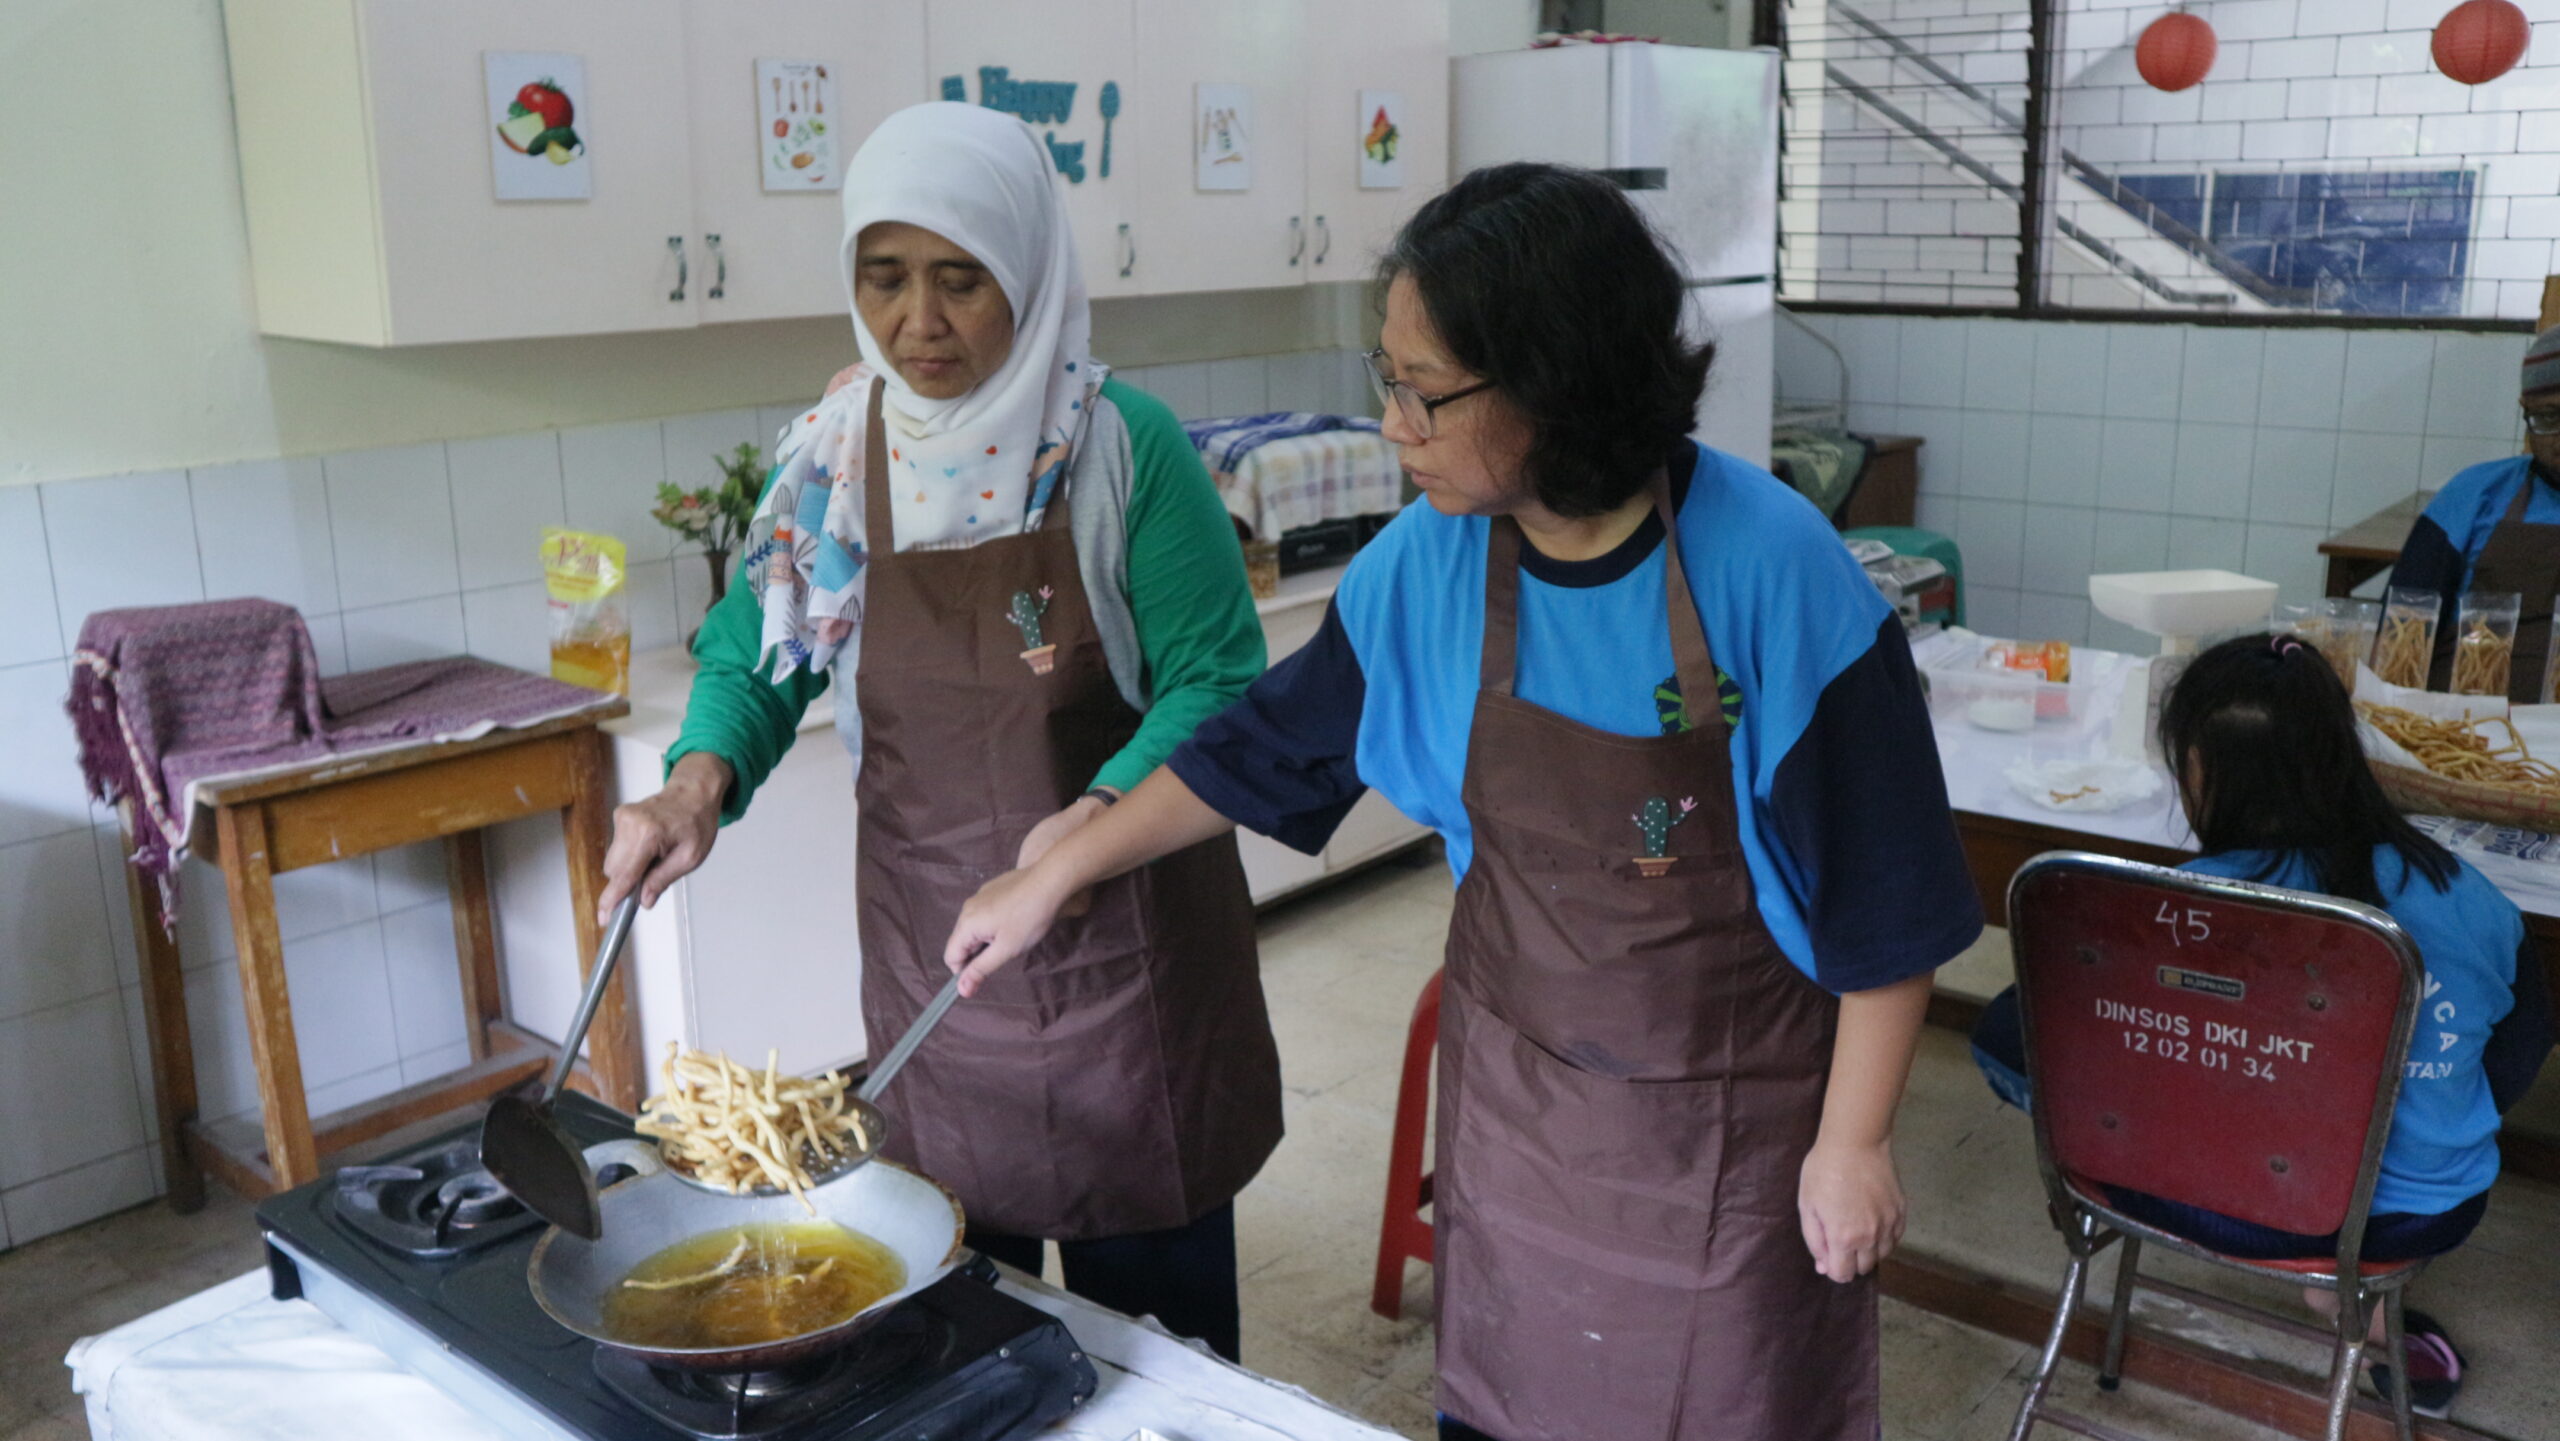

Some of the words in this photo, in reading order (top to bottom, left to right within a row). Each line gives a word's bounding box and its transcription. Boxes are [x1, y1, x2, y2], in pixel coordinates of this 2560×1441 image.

[2155, 900, 2213, 948] 45
[2095, 997, 2191, 1038] DINSOS
[2204, 1020, 2248, 1049] DKI
[2258, 1034, 2315, 1063] JKT
[2123, 1031, 2149, 1054] 12
[2157, 1038, 2190, 1063] 02
[2199, 1047, 2228, 1072] 01
[2242, 1056, 2277, 1083] 34
[2403, 1060, 2453, 1080] TAN
